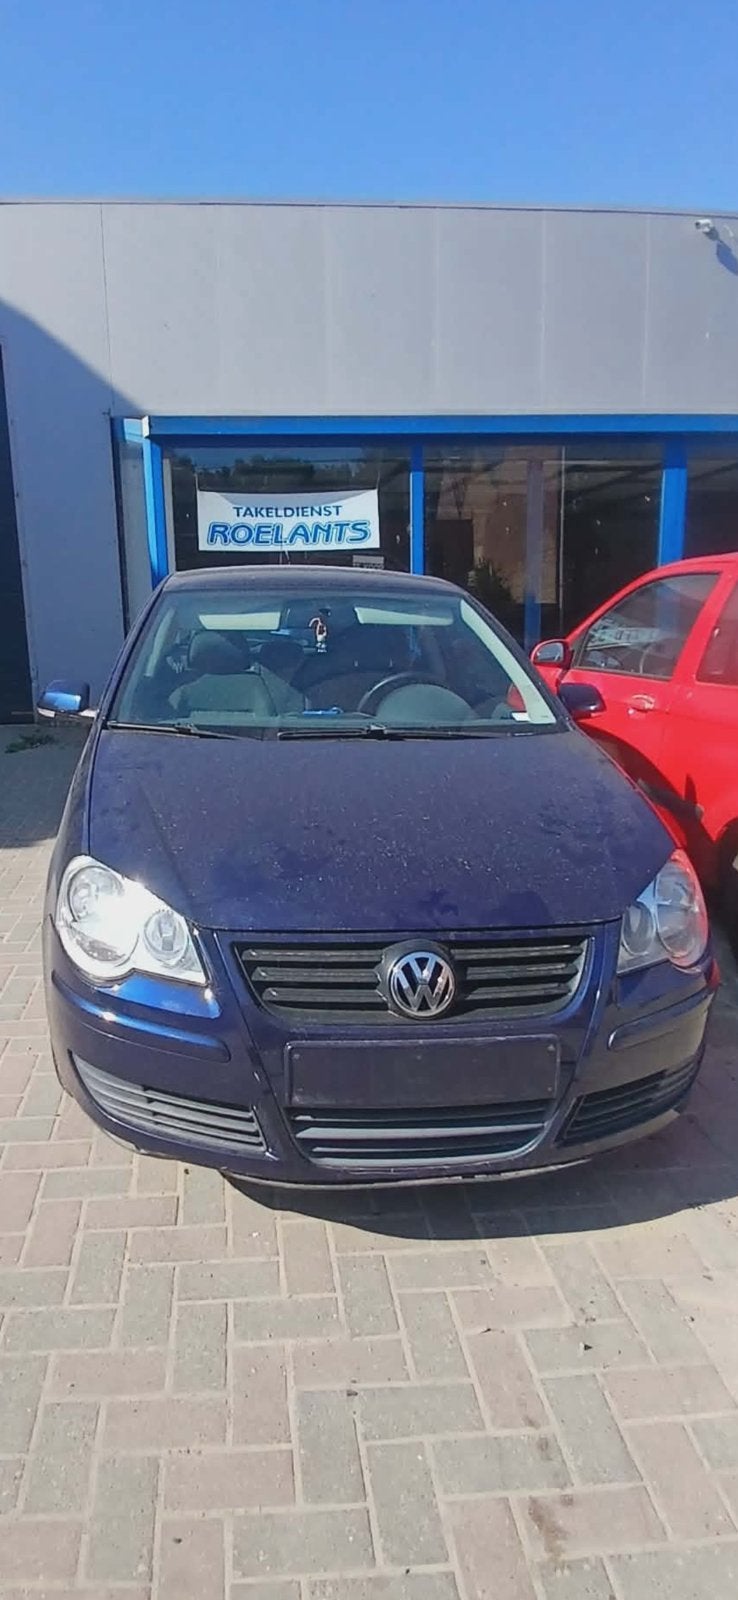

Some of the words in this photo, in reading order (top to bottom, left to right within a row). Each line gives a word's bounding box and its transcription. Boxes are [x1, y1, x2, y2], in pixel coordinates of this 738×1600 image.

[233, 505, 343, 518] TAKELDIENST
[206, 520, 372, 546] ROELANTS
[392, 952, 454, 1015] VW
